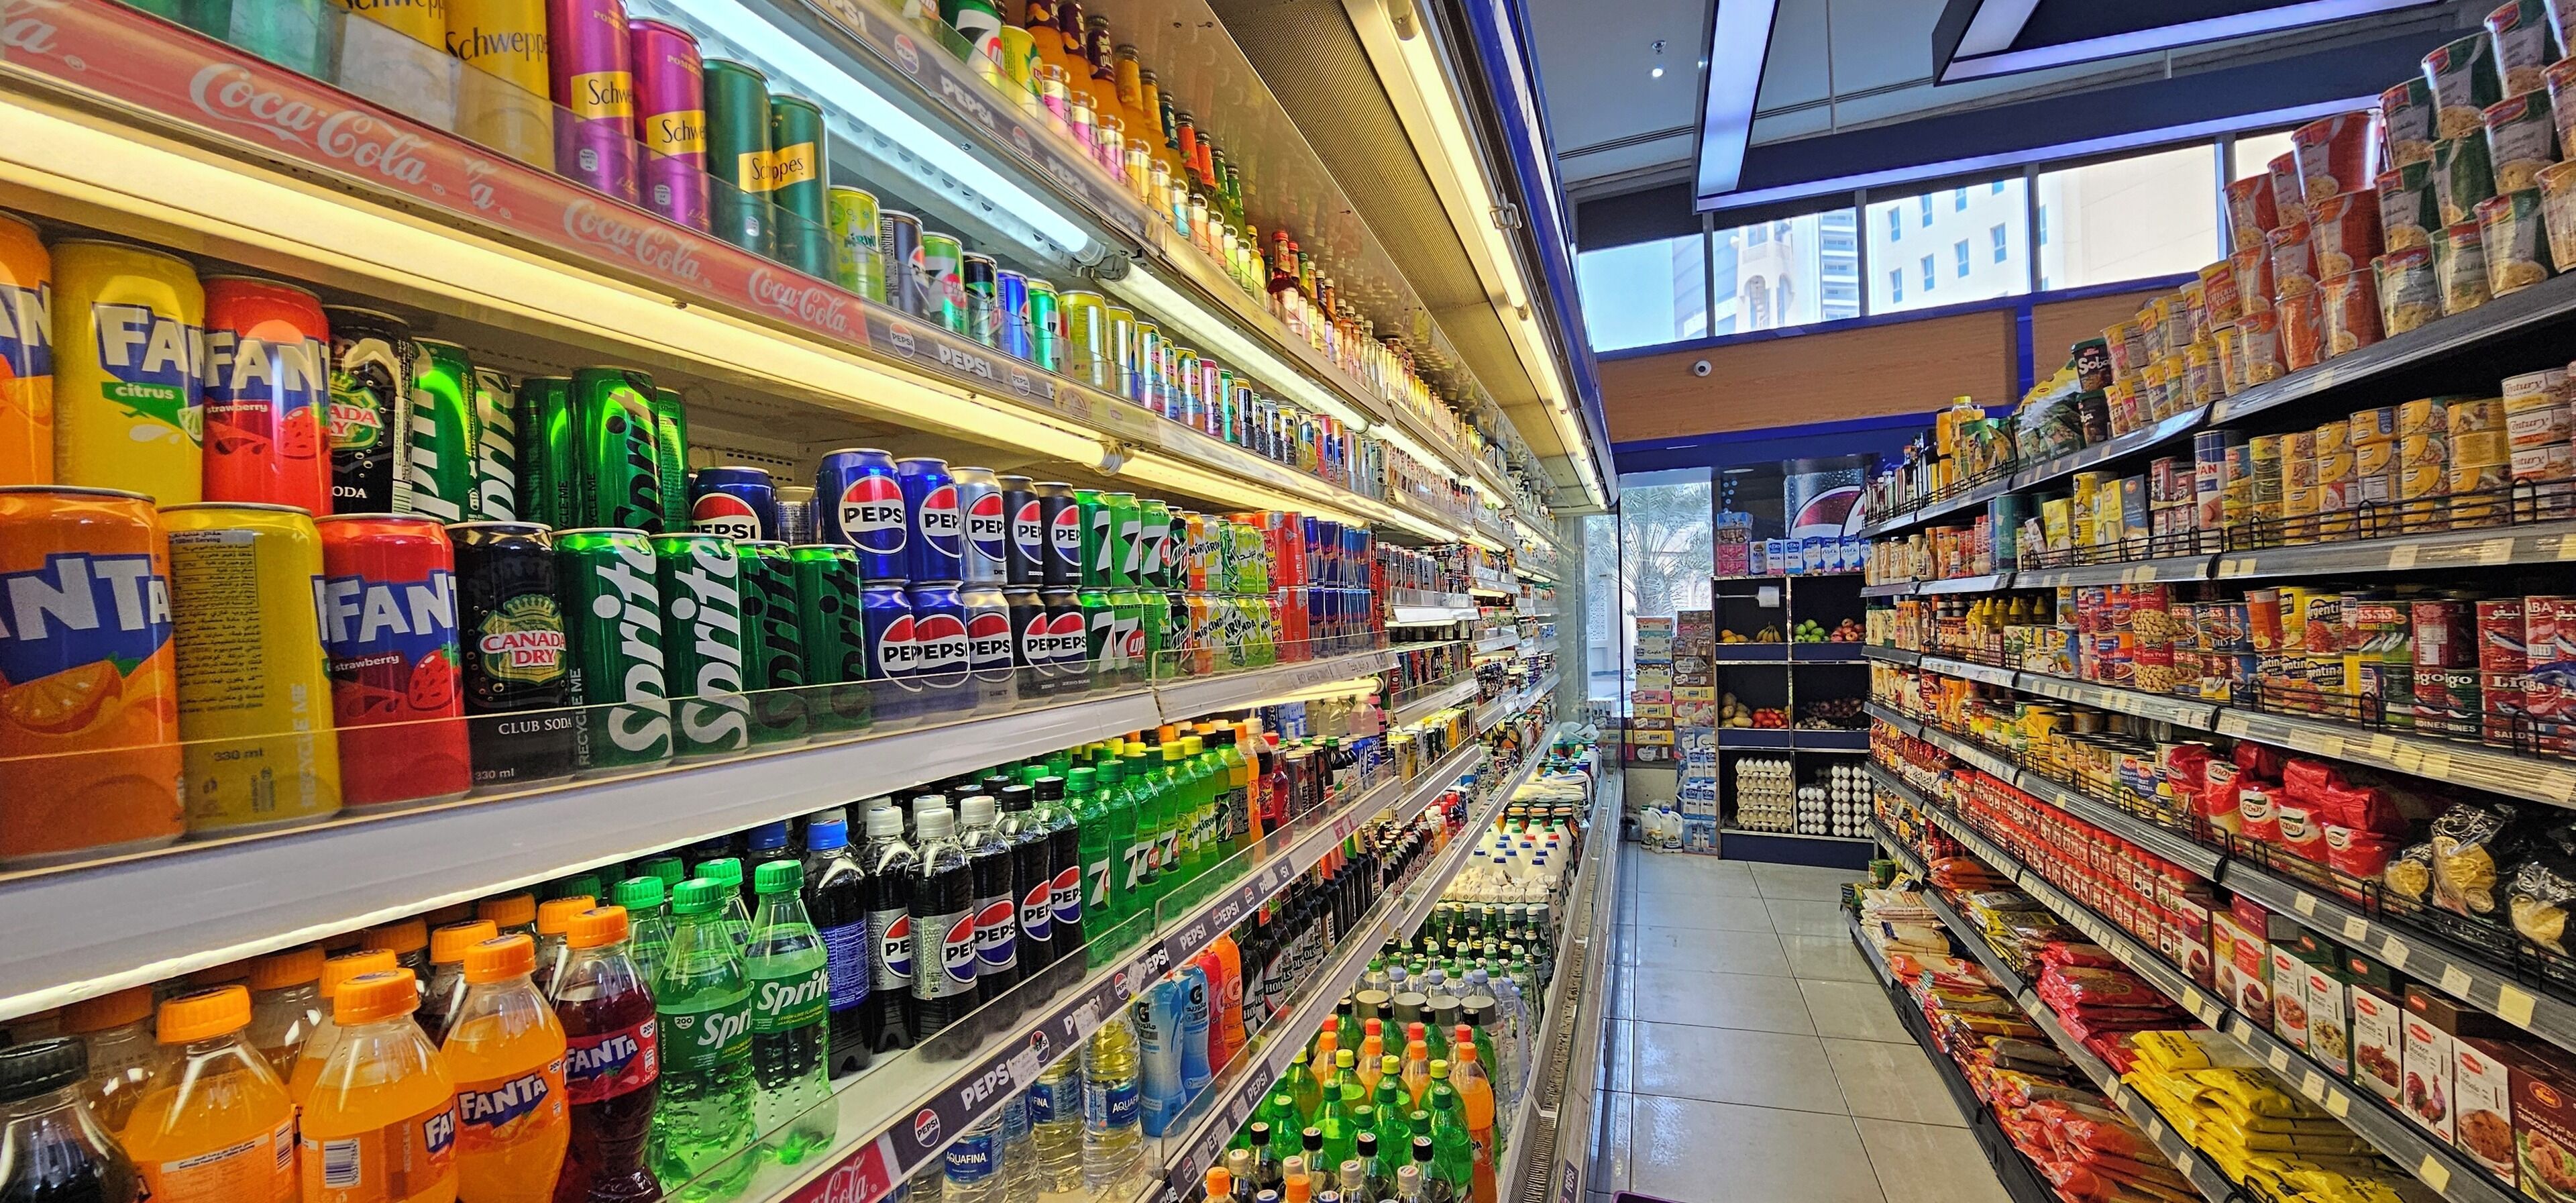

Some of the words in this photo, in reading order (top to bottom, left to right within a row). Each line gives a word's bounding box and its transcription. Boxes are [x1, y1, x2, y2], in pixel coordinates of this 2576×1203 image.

[941, 74, 995, 125] PEPSI
[891, 331, 915, 348] PEPSI
[938, 344, 993, 381] PEPSI
[115, 385, 174, 400] citrus
[207, 402, 268, 413] strawberry
[1141, 525, 1169, 575] 7
[482, 631, 566, 651] CANADA
[592, 533, 674, 758] Sprite
[672, 539, 751, 749] Sprite
[1115, 617, 1139, 670] 7
[335, 655, 399, 672] strawberry
[515, 649, 556, 666] DRY
[570, 668, 582, 692] ME
[291, 682, 309, 715] ME
[498, 721, 540, 735] CLUB
[544, 717, 572, 731] SODA
[572, 696, 590, 766] RECYCLE
[213, 750, 241, 762] 330
[244, 748, 264, 760] ml
[474, 770, 496, 780] 330
[499, 768, 515, 778] ml
[1179, 923, 1207, 951] PEPSI
[643, 1023, 654, 1033] 200
[676, 1017, 693, 1025] 200
[549, 1060, 561, 1069] 200
[567, 1034, 639, 1074] FANTA
[1247, 1071, 1268, 1101] PEPSI
[458, 1075, 547, 1120] FANTA
[916, 1118, 939, 1139] PEPSI
[946, 1151, 987, 1165] AQUAFINA
